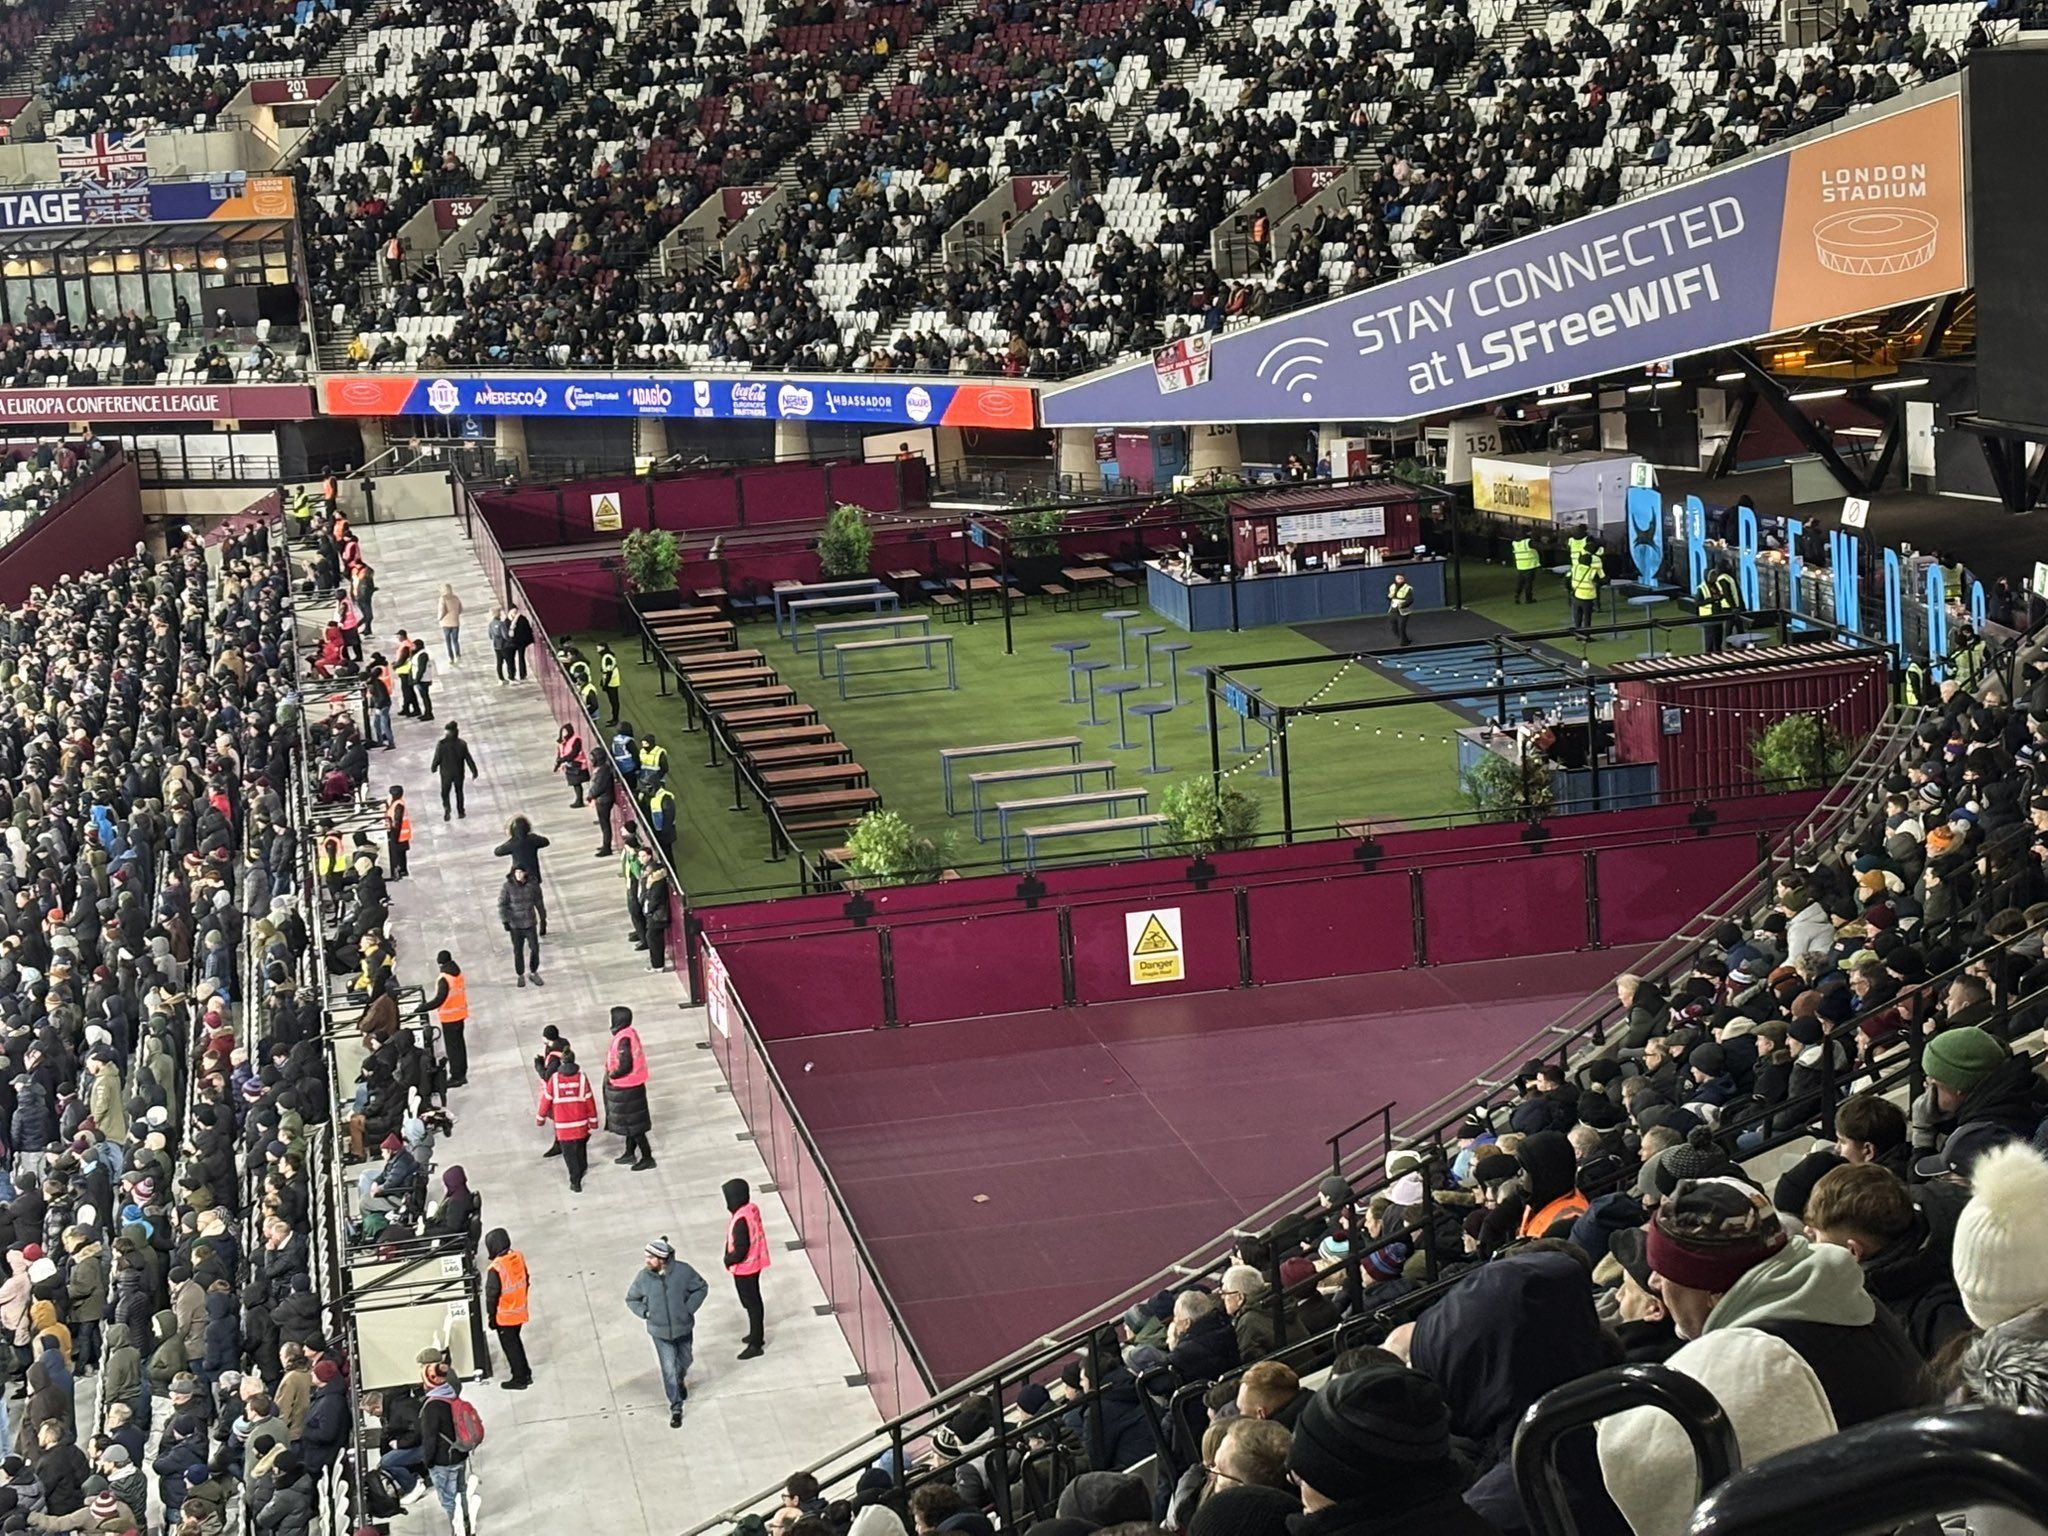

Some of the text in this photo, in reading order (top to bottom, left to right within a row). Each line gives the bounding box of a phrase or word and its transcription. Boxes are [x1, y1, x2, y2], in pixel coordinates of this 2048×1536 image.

[287, 80, 307, 92] 201
[1821, 163, 1926, 185] LONDON
[1031, 180, 1053, 194] 254
[1822, 181, 1927, 203] STADIUM
[741, 190, 762, 205] 255
[0, 193, 83, 226] TAGE
[451, 203, 473, 216] 256
[1352, 196, 1745, 356] STAY CONNECTED
[1407, 262, 1721, 395] at LSFreeWIFI
[7, 398, 64, 415] EUROPA
[66, 396, 161, 414] CONFERENCE
[163, 395, 220, 413] LEAGUE
[475, 391, 534, 405] AMERESCO
[633, 383, 672, 407] ADAGIO
[825, 389, 892, 413] AMBASSADOR
[1466, 435, 1497, 454] 152
[1139, 960, 1173, 970] Danger
